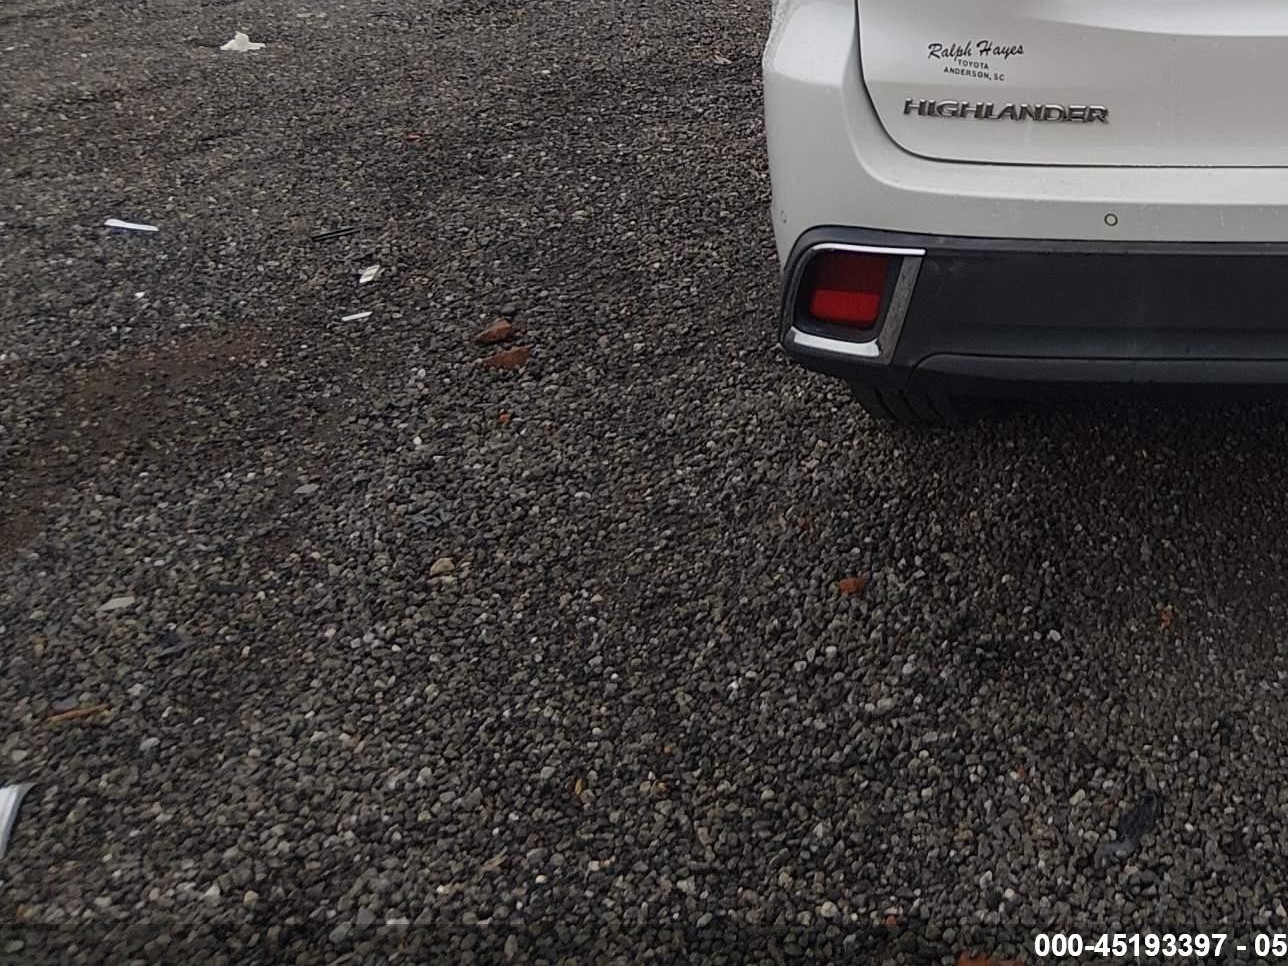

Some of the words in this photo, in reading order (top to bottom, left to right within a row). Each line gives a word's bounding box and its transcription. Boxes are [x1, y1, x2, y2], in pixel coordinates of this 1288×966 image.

[927, 40, 973, 62] Ralph
[976, 40, 1025, 60] Hayes
[957, 58, 989, 70] TOYOTA
[943, 66, 992, 81] ANDERSON,
[993, 72, 1005, 82] SC
[903, 97, 1110, 124] HIGHLANDER
